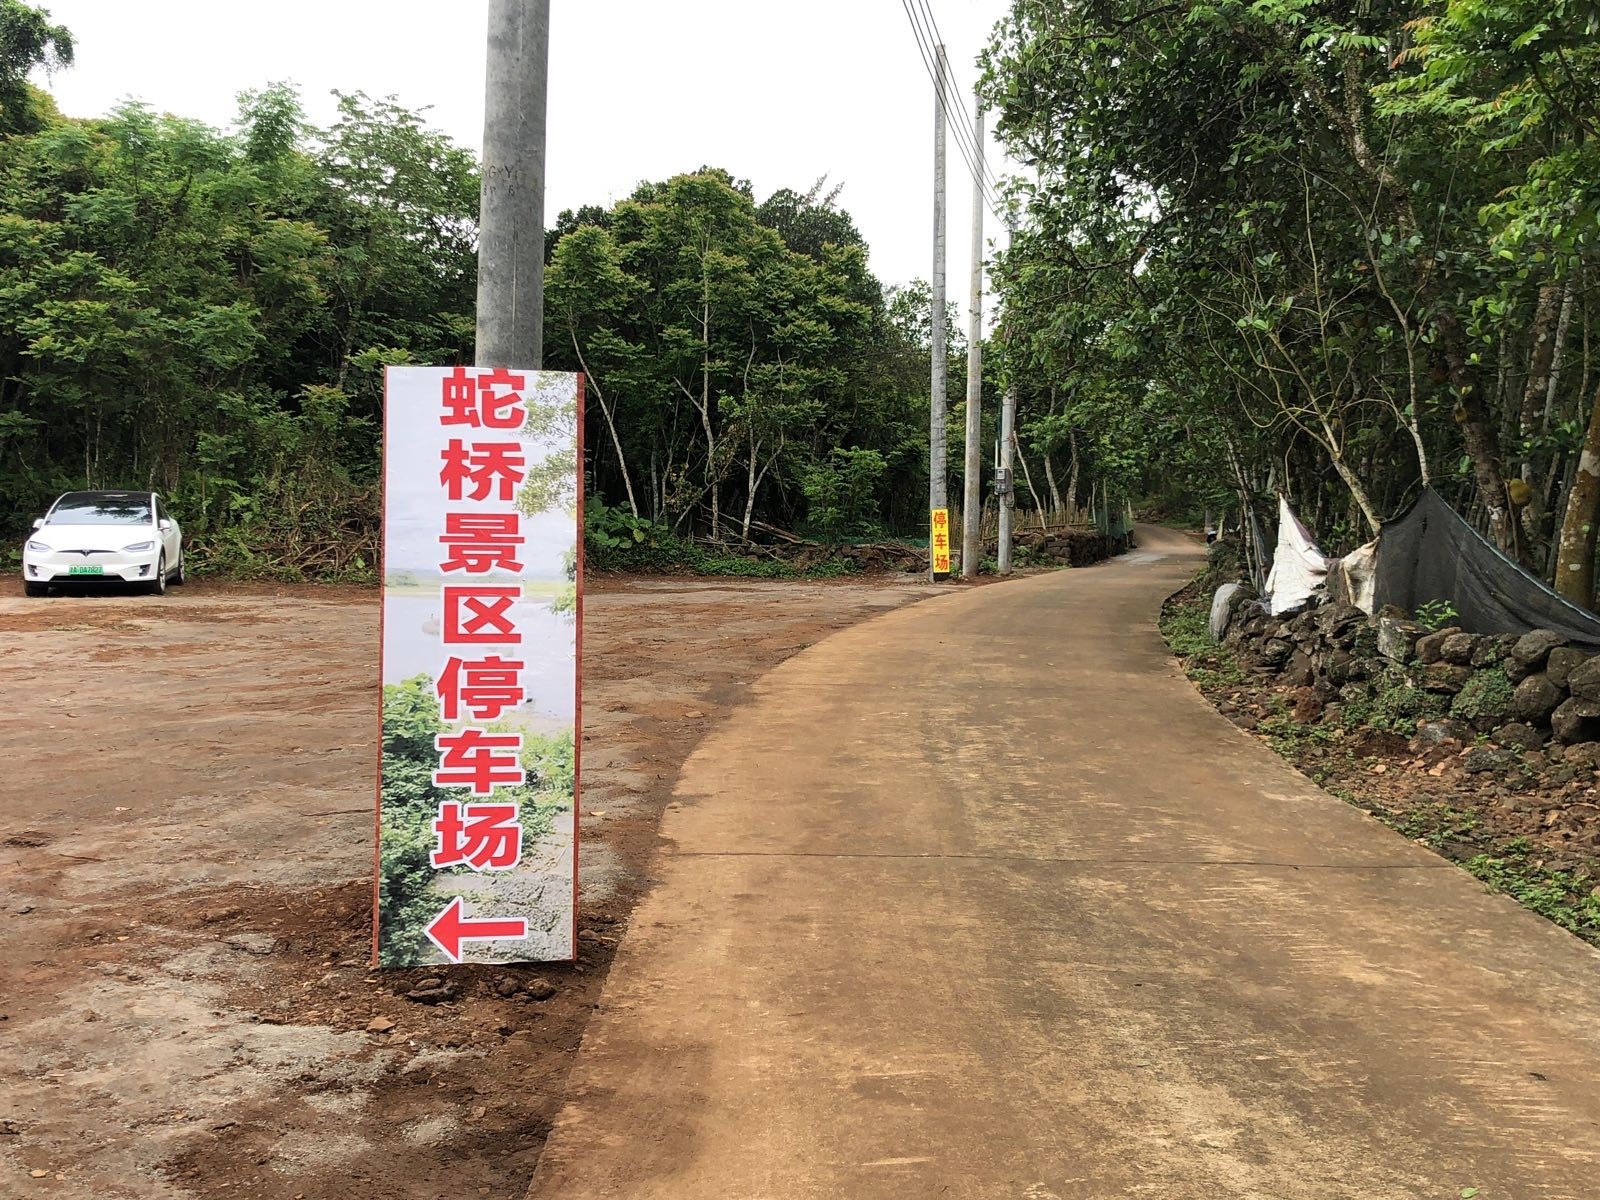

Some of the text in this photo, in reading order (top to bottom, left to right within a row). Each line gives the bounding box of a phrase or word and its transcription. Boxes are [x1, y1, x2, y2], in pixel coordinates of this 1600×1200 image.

[434, 367, 525, 868] 蛇桥景区停车场
[933, 511, 949, 571] 停车场
